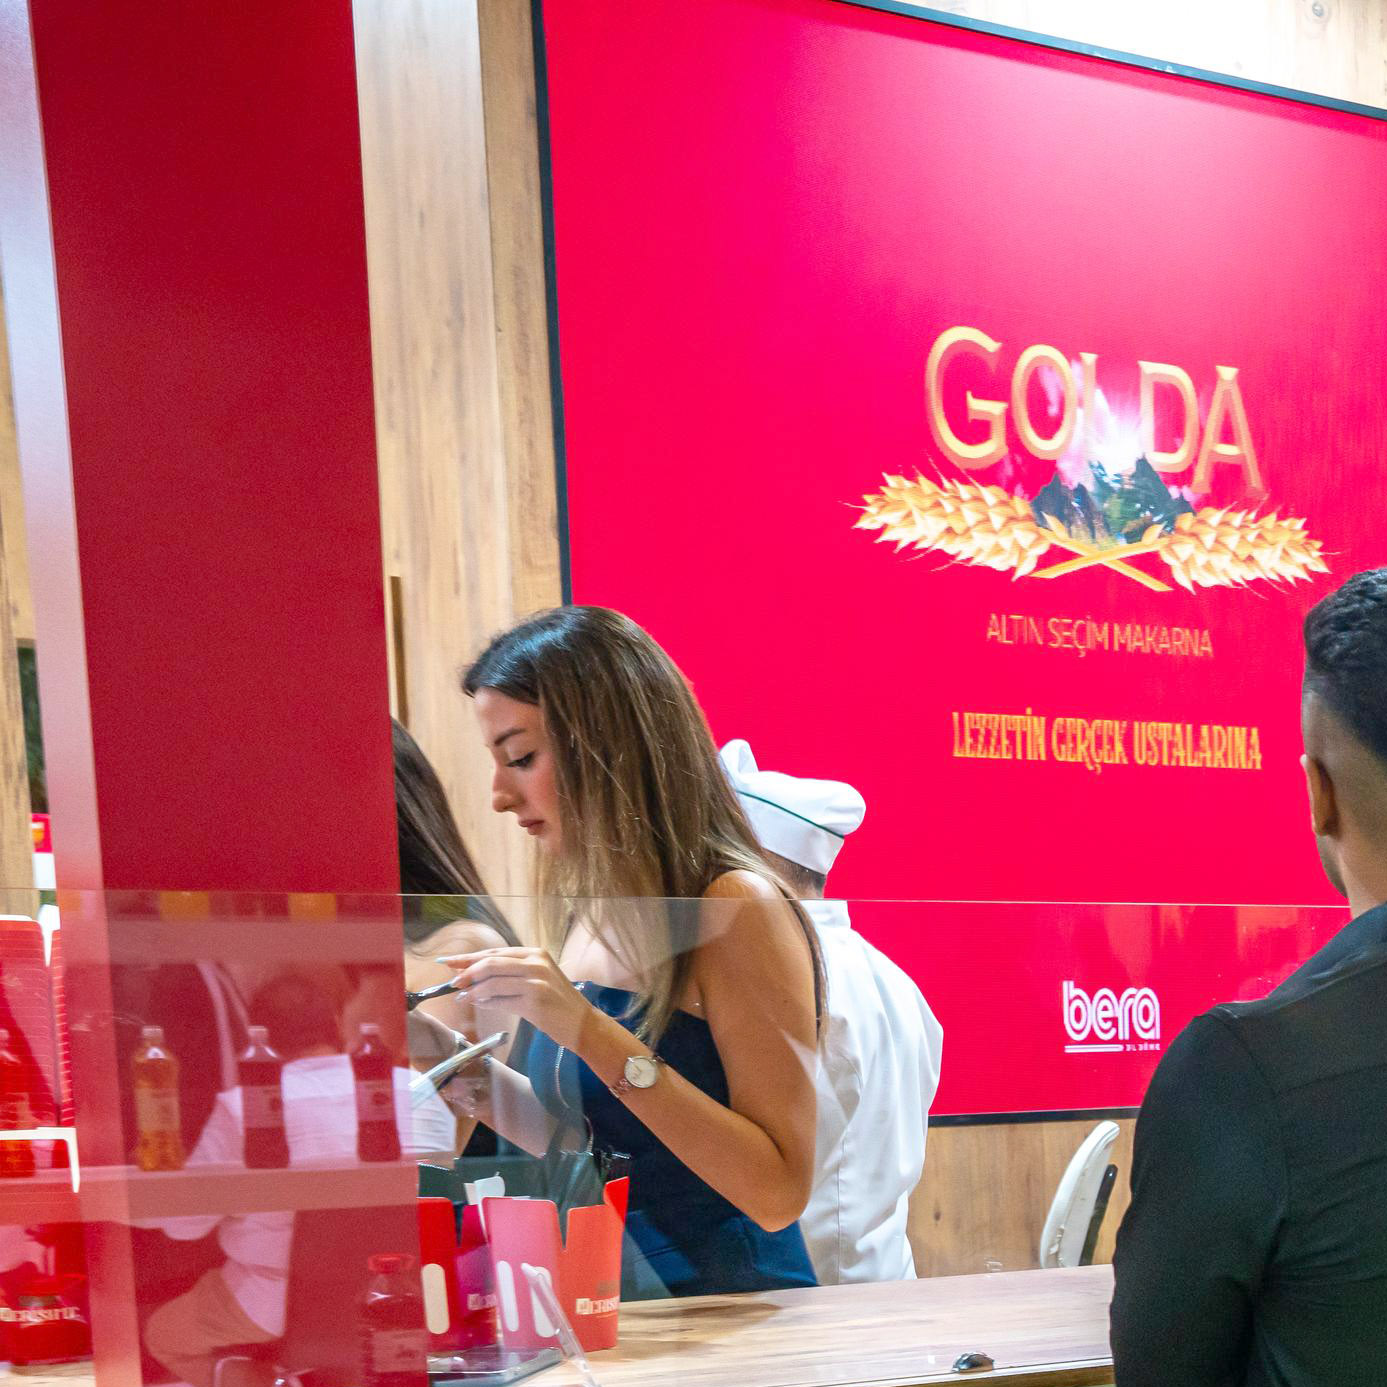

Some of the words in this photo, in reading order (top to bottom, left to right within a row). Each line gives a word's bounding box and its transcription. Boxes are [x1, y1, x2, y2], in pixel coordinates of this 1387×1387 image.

[986, 613, 1043, 644] ALTIN
[1113, 622, 1214, 657] MAKARNA
[952, 707, 1046, 761] LEZZETİN
[1052, 717, 1128, 774] GERÇEK
[1134, 721, 1262, 770] USTALARINA
[1062, 981, 1161, 1041] bera
